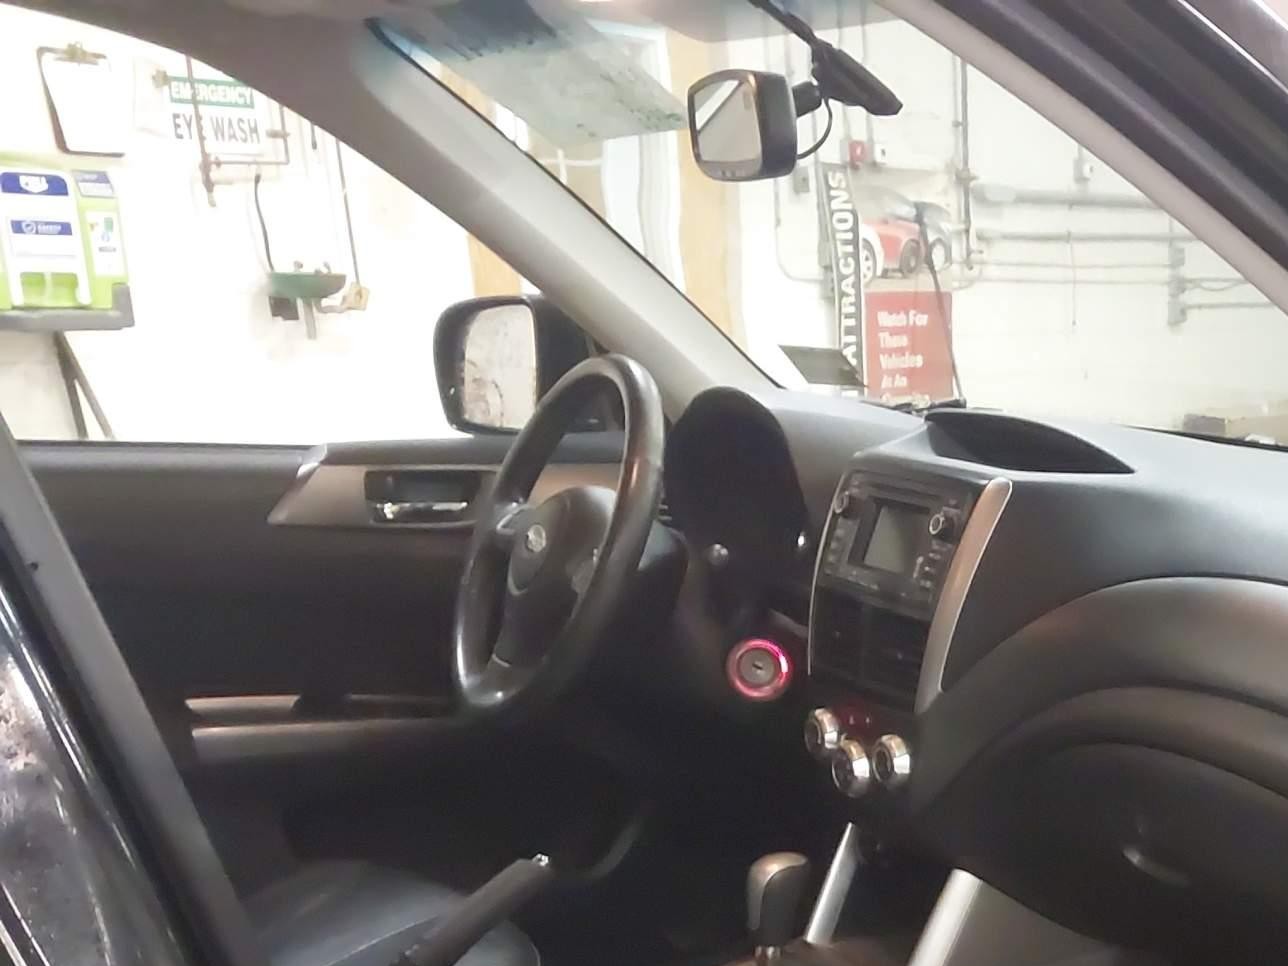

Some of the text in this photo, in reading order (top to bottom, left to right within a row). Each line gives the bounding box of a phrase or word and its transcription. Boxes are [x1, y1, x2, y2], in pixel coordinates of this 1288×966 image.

[210, 116, 260, 144] WASH
[827, 170, 858, 366] ATTRACTIONS
[908, 309, 928, 327] For
